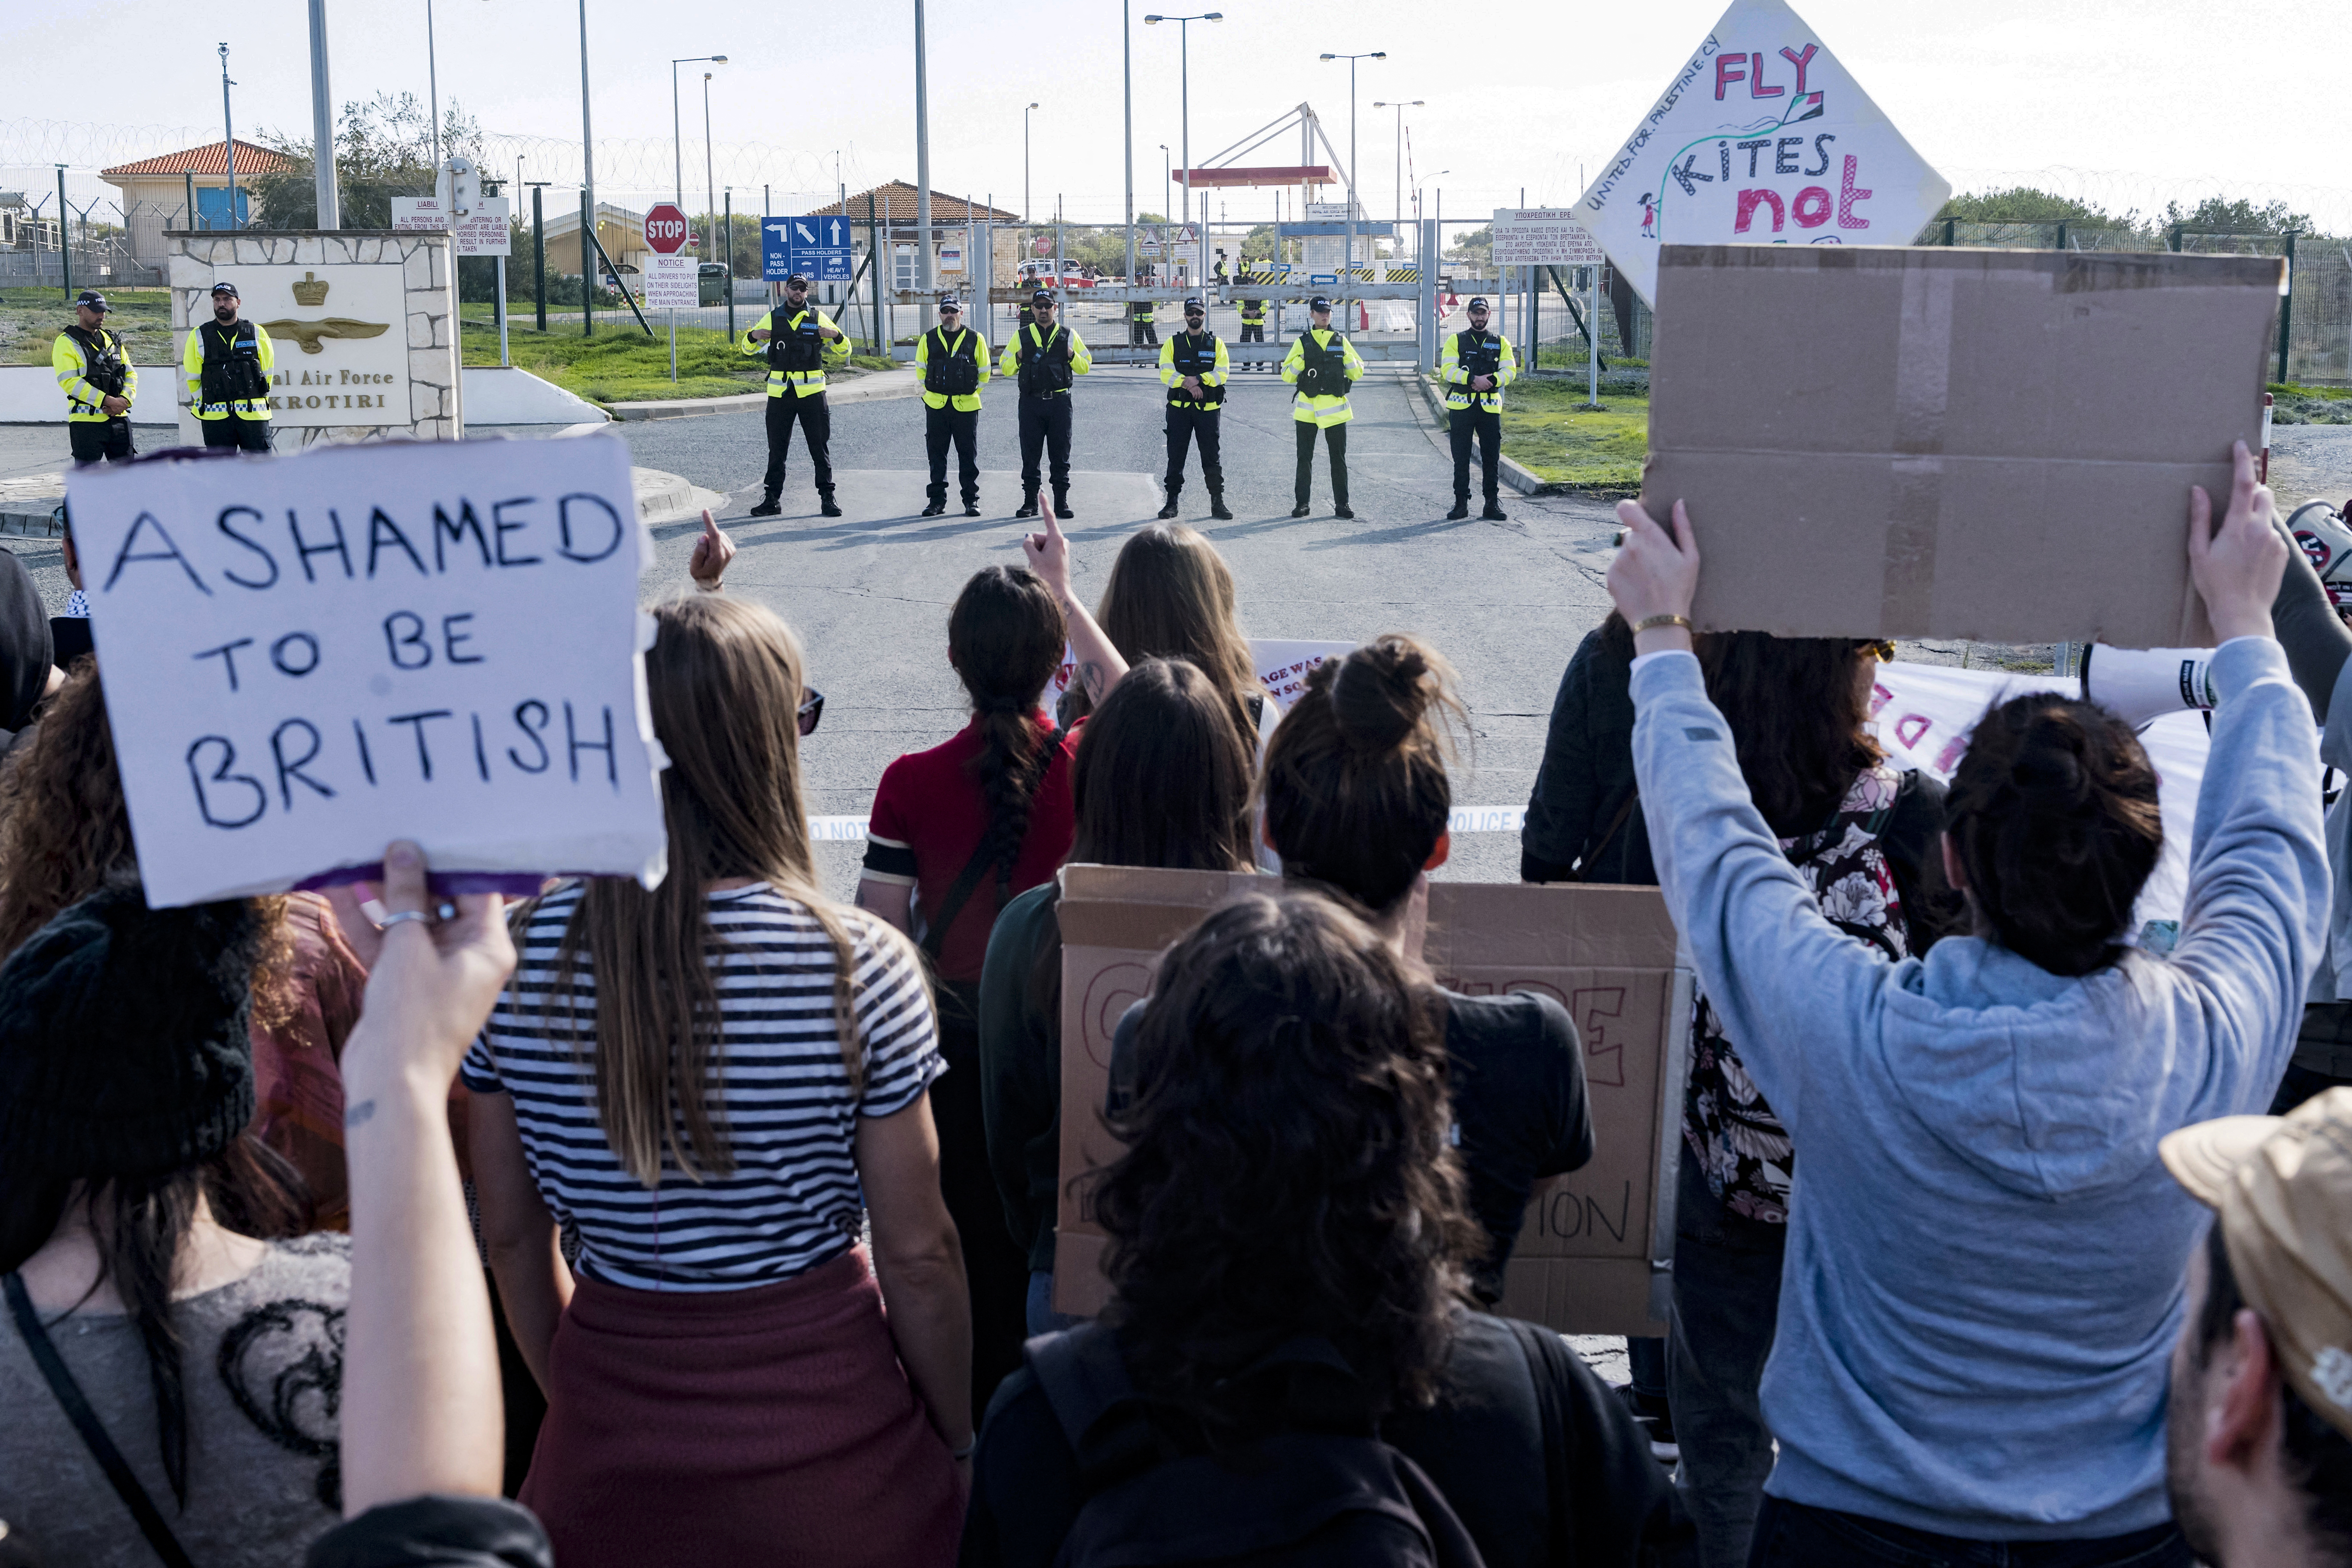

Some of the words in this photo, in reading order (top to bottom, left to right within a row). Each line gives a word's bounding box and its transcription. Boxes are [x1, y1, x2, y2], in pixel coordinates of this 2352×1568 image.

[1714, 43, 1819, 101] FLY
[1734, 155, 1873, 235] not
[647, 220, 683, 239] STOP
[268, 394, 385, 409] KROTIRI
[301, 370, 332, 385] Air
[339, 369, 394, 384] Force
[103, 491, 624, 596] ASHAMED
[193, 631, 320, 692] TO
[383, 610, 485, 670] BE
[186, 698, 619, 829] BRITISH
[830, 821, 869, 839] NOT
